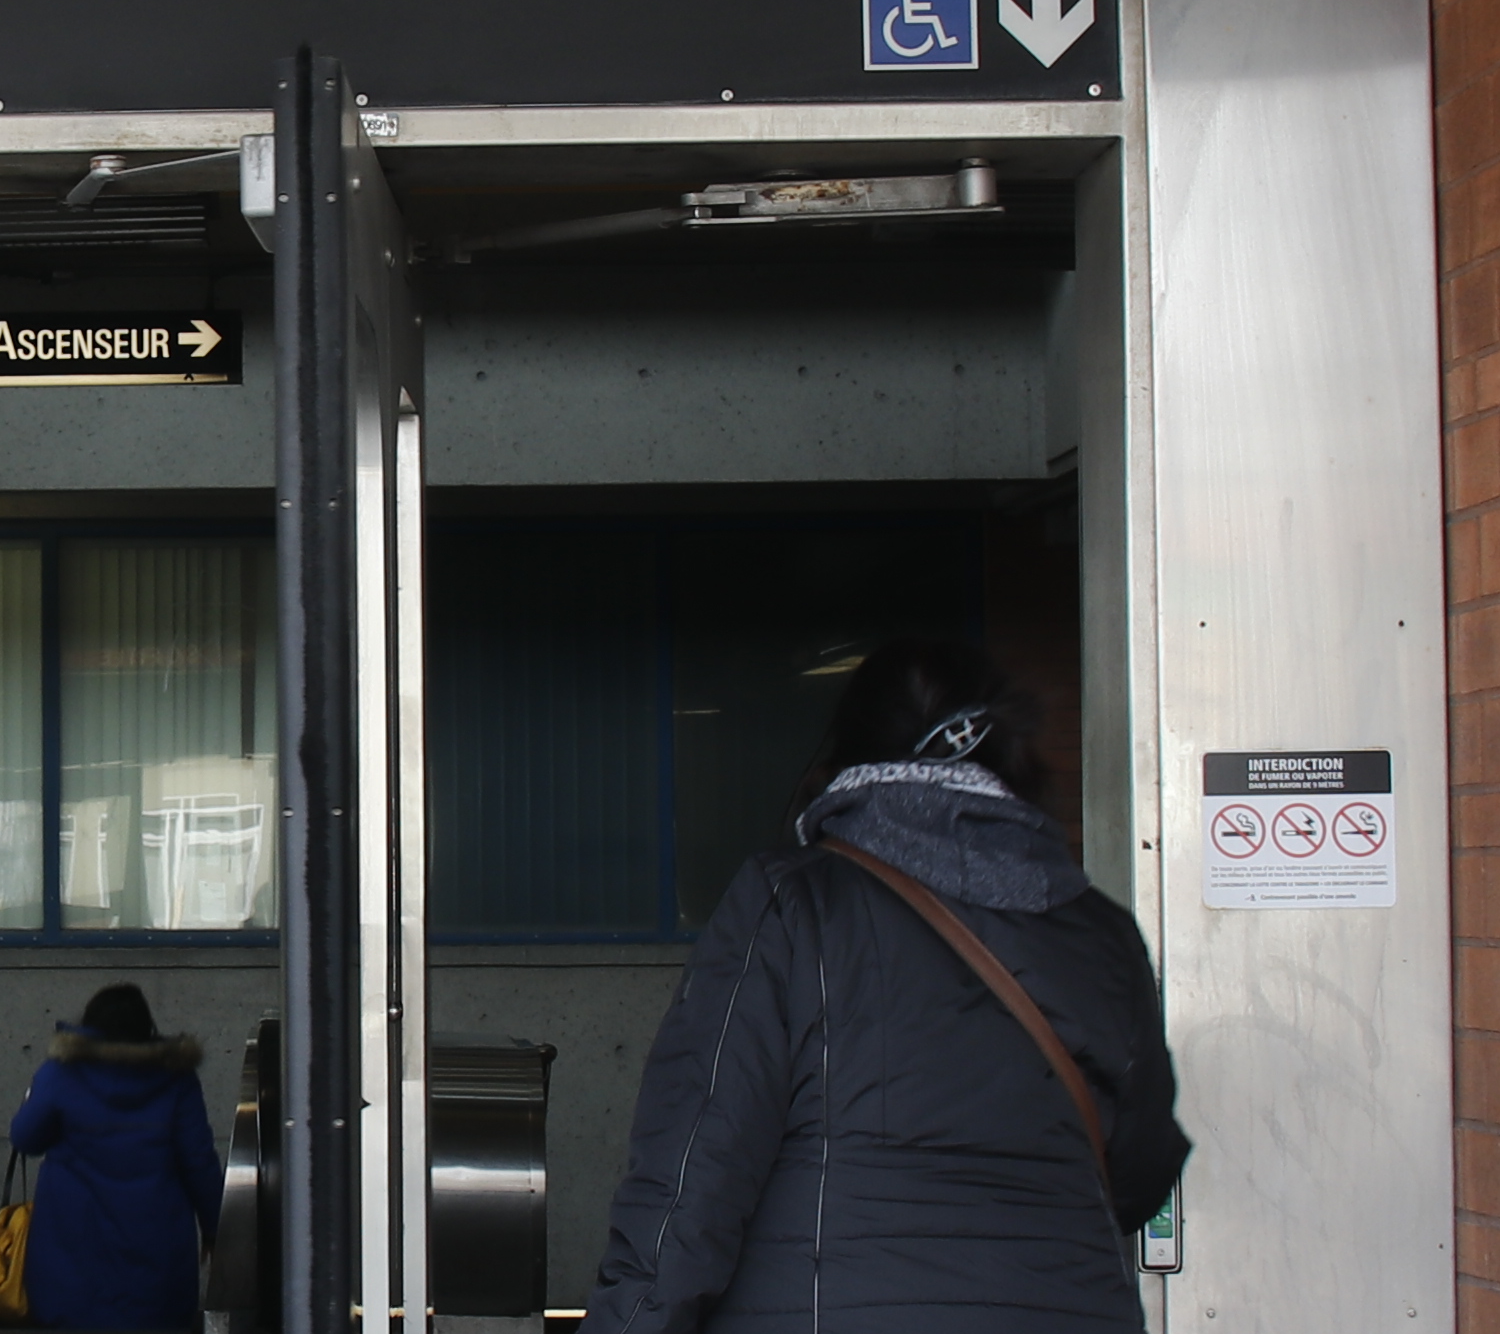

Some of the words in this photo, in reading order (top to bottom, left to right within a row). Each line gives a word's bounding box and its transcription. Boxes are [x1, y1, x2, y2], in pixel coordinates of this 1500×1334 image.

[1248, 758, 1344, 771] INTERDICTION
[1248, 773, 1260, 781] DE
[1261, 772, 1290, 780] FUMER
[1306, 771, 1344, 780] VAPOTER
